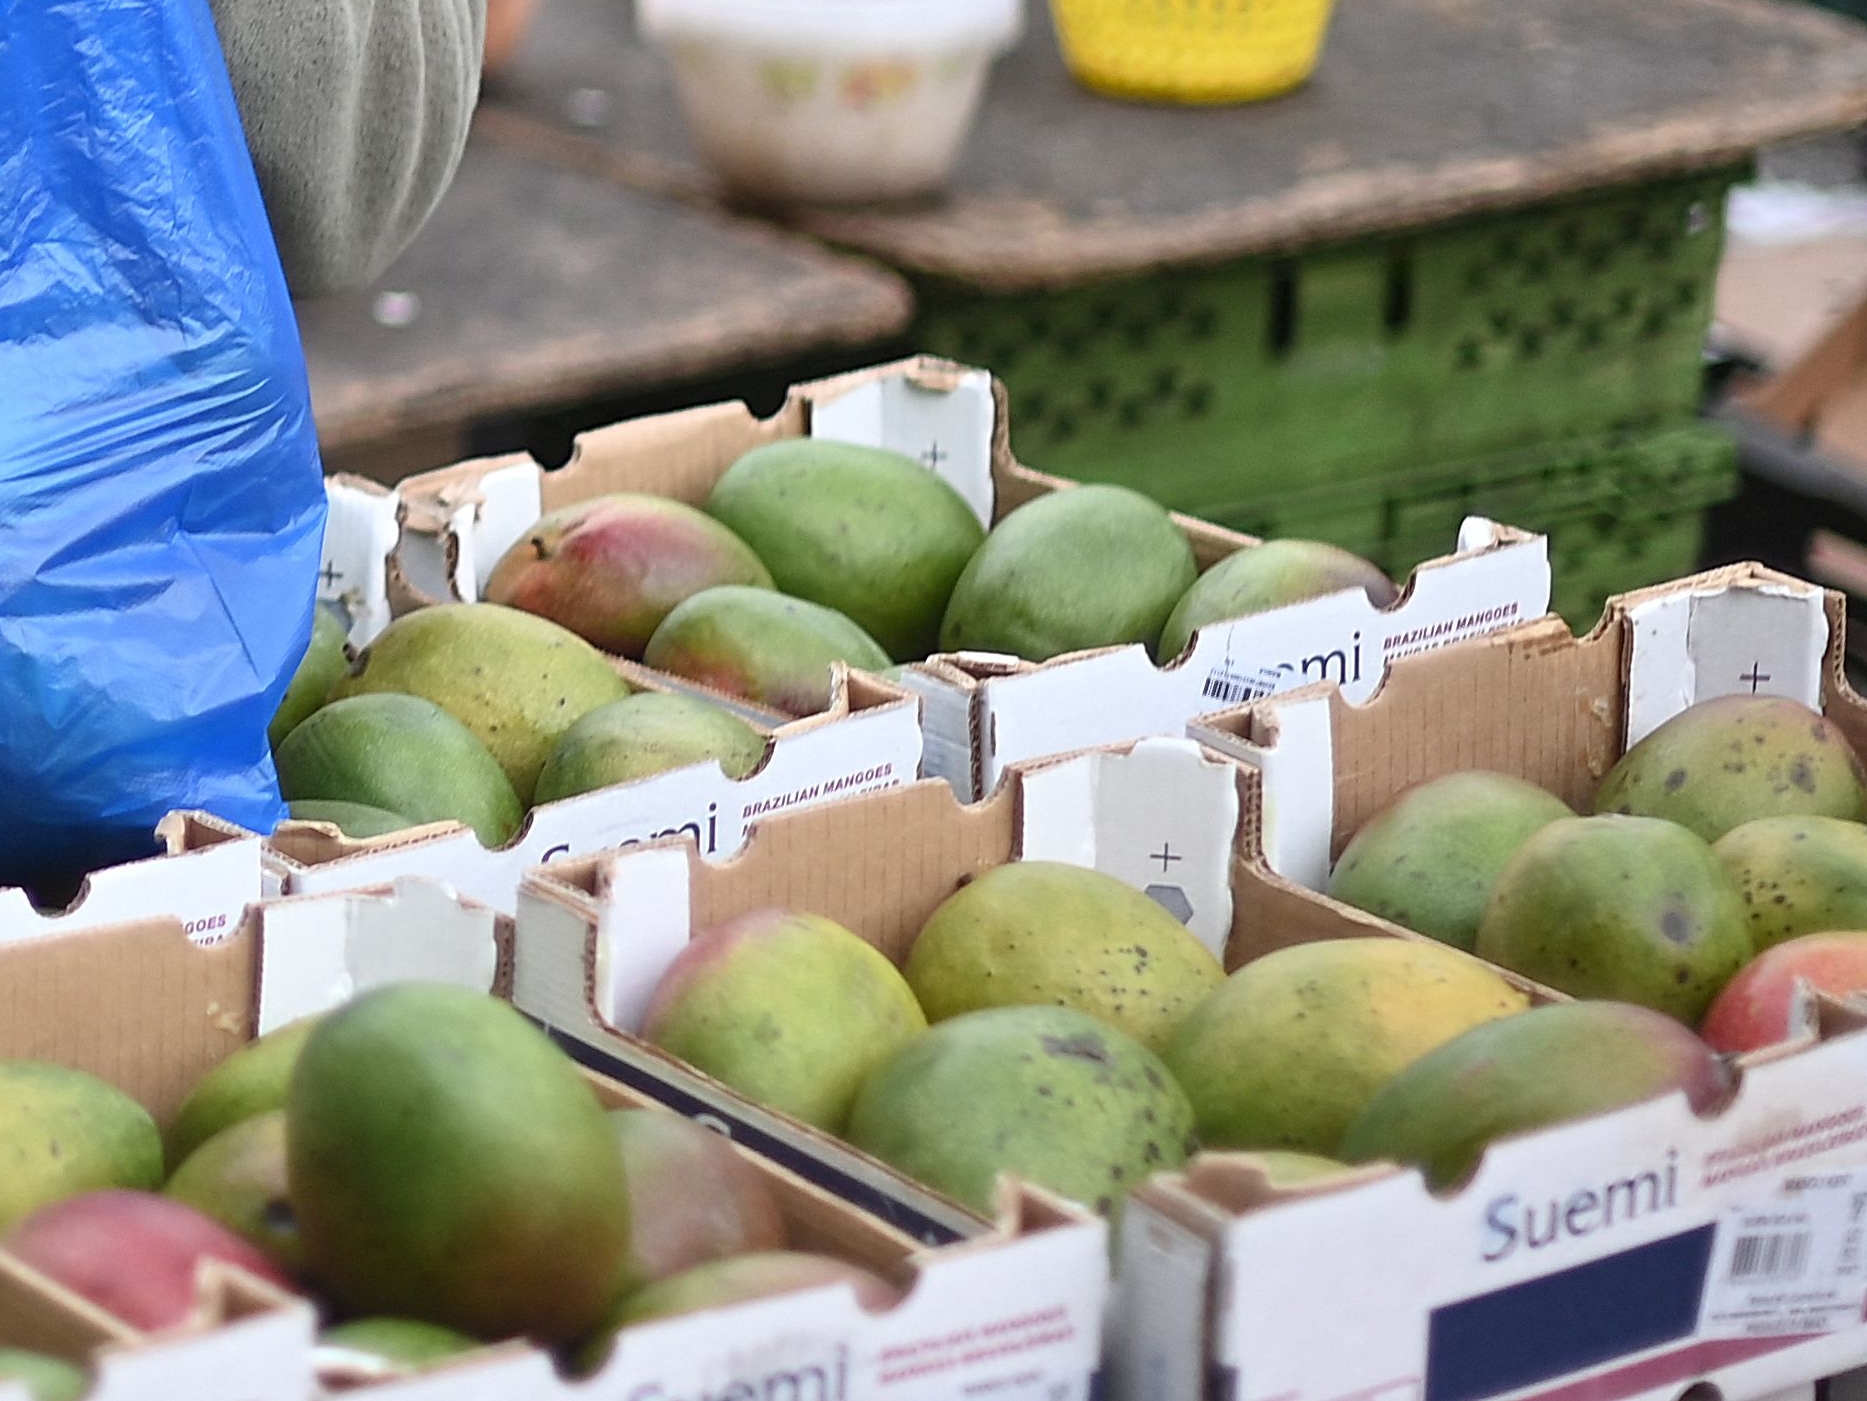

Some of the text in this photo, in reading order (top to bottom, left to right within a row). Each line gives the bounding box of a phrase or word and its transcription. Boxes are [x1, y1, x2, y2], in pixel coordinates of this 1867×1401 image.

[1383, 620, 1453, 650] BRAZILIAN
[1456, 601, 1519, 630] MANGOES
[742, 784, 820, 818] BRAZILIAN
[823, 763, 893, 795] MANGOES
[184, 913, 227, 935] GOES
[1481, 1145, 1680, 1263] Suemi
